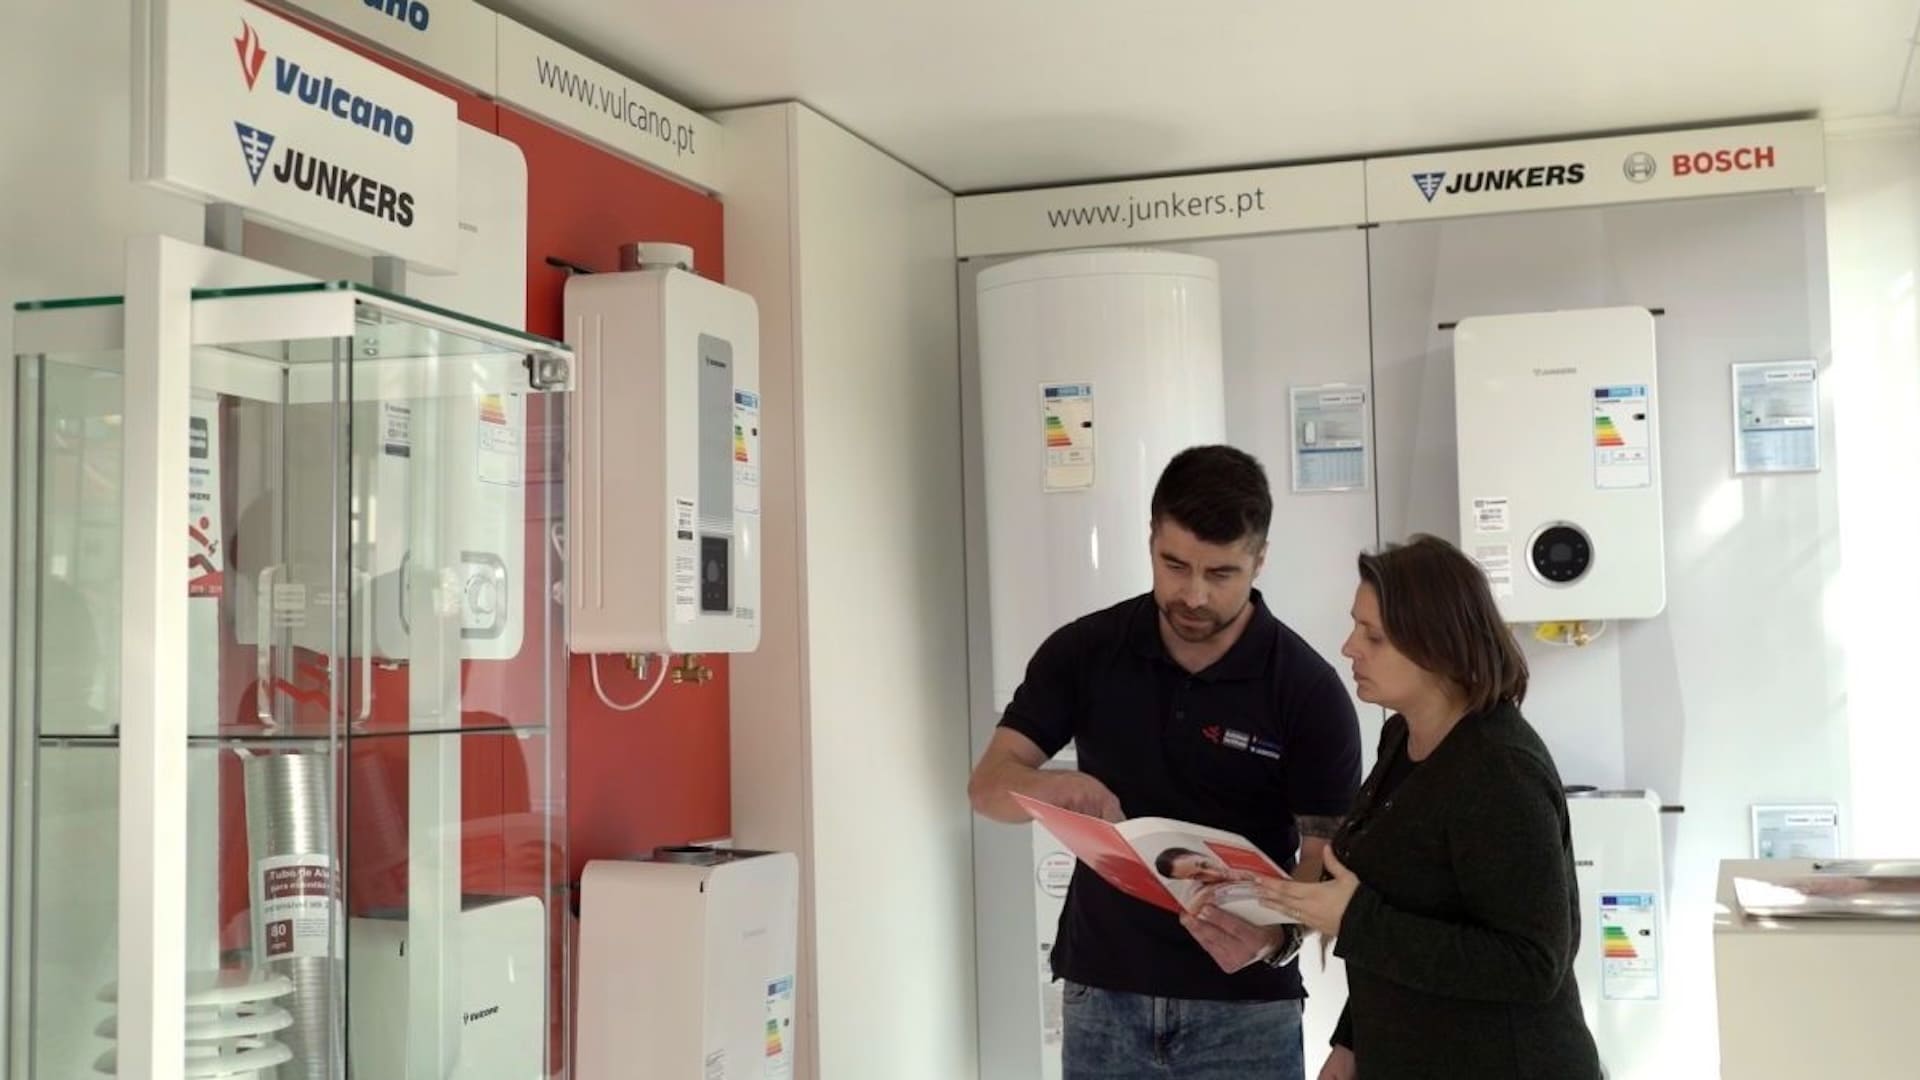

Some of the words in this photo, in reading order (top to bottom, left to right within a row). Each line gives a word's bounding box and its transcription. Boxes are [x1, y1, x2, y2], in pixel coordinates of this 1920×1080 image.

[273, 56, 414, 145] Vulcano
[536, 55, 696, 156] www.vulcano.pt
[1446, 163, 1586, 194] JUNKERS
[1672, 147, 1775, 177] BOSCH
[273, 148, 415, 227] JUNKERS
[1047, 185, 1266, 229] www.junkers.pt
[270, 924, 287, 937] 80
